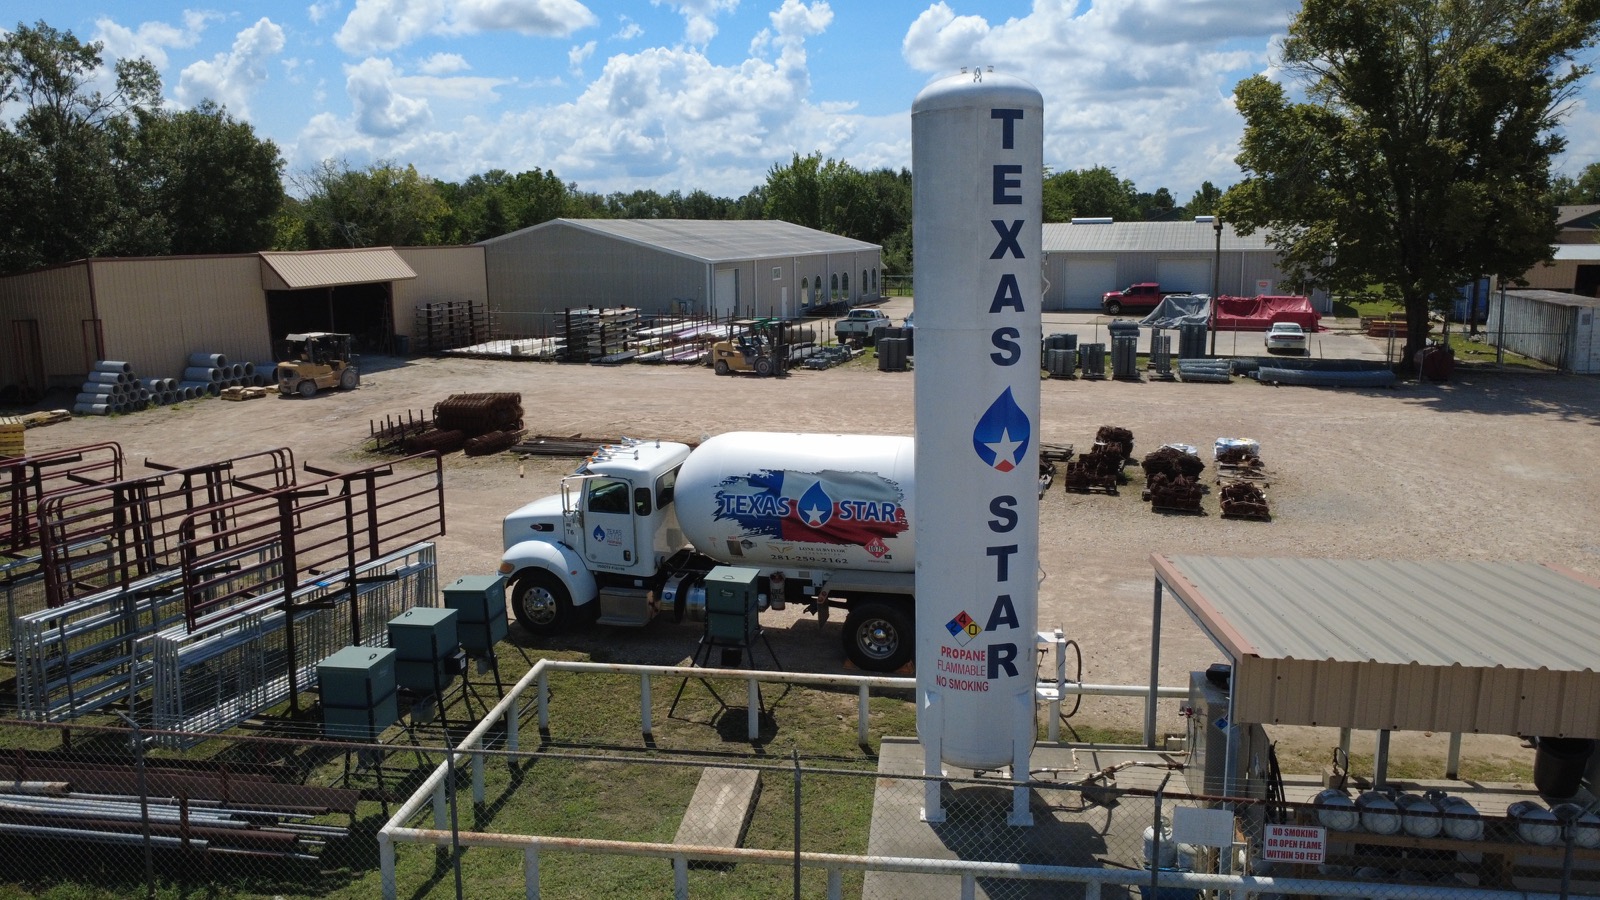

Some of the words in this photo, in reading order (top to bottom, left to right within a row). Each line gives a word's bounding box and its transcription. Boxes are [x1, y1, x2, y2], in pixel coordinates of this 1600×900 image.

[989, 109, 1025, 367] TEXAS
[723, 494, 790, 517] TEXAS
[839, 500, 897, 523] STAR
[771, 554, 849, 564] 281-259-2162
[984, 495, 1020, 679] STAR
[959, 613, 967, 625] 4
[951, 621, 958, 633] 2
[941, 645, 986, 662] PROPANE
[937, 659, 986, 677] FLAMMABLE
[936, 674, 948, 688] NO
[949, 678, 989, 692] SMOKING
[1272, 828, 1283, 836] NO
[1284, 828, 1318, 838] SMOKING
[1268, 839, 1278, 847] OR
[1280, 840, 1297, 848] OPEN
[1299, 841, 1322, 850] FLAME
[1266, 850, 1294, 859] WITHIN
[1295, 852, 1305, 860] 50
